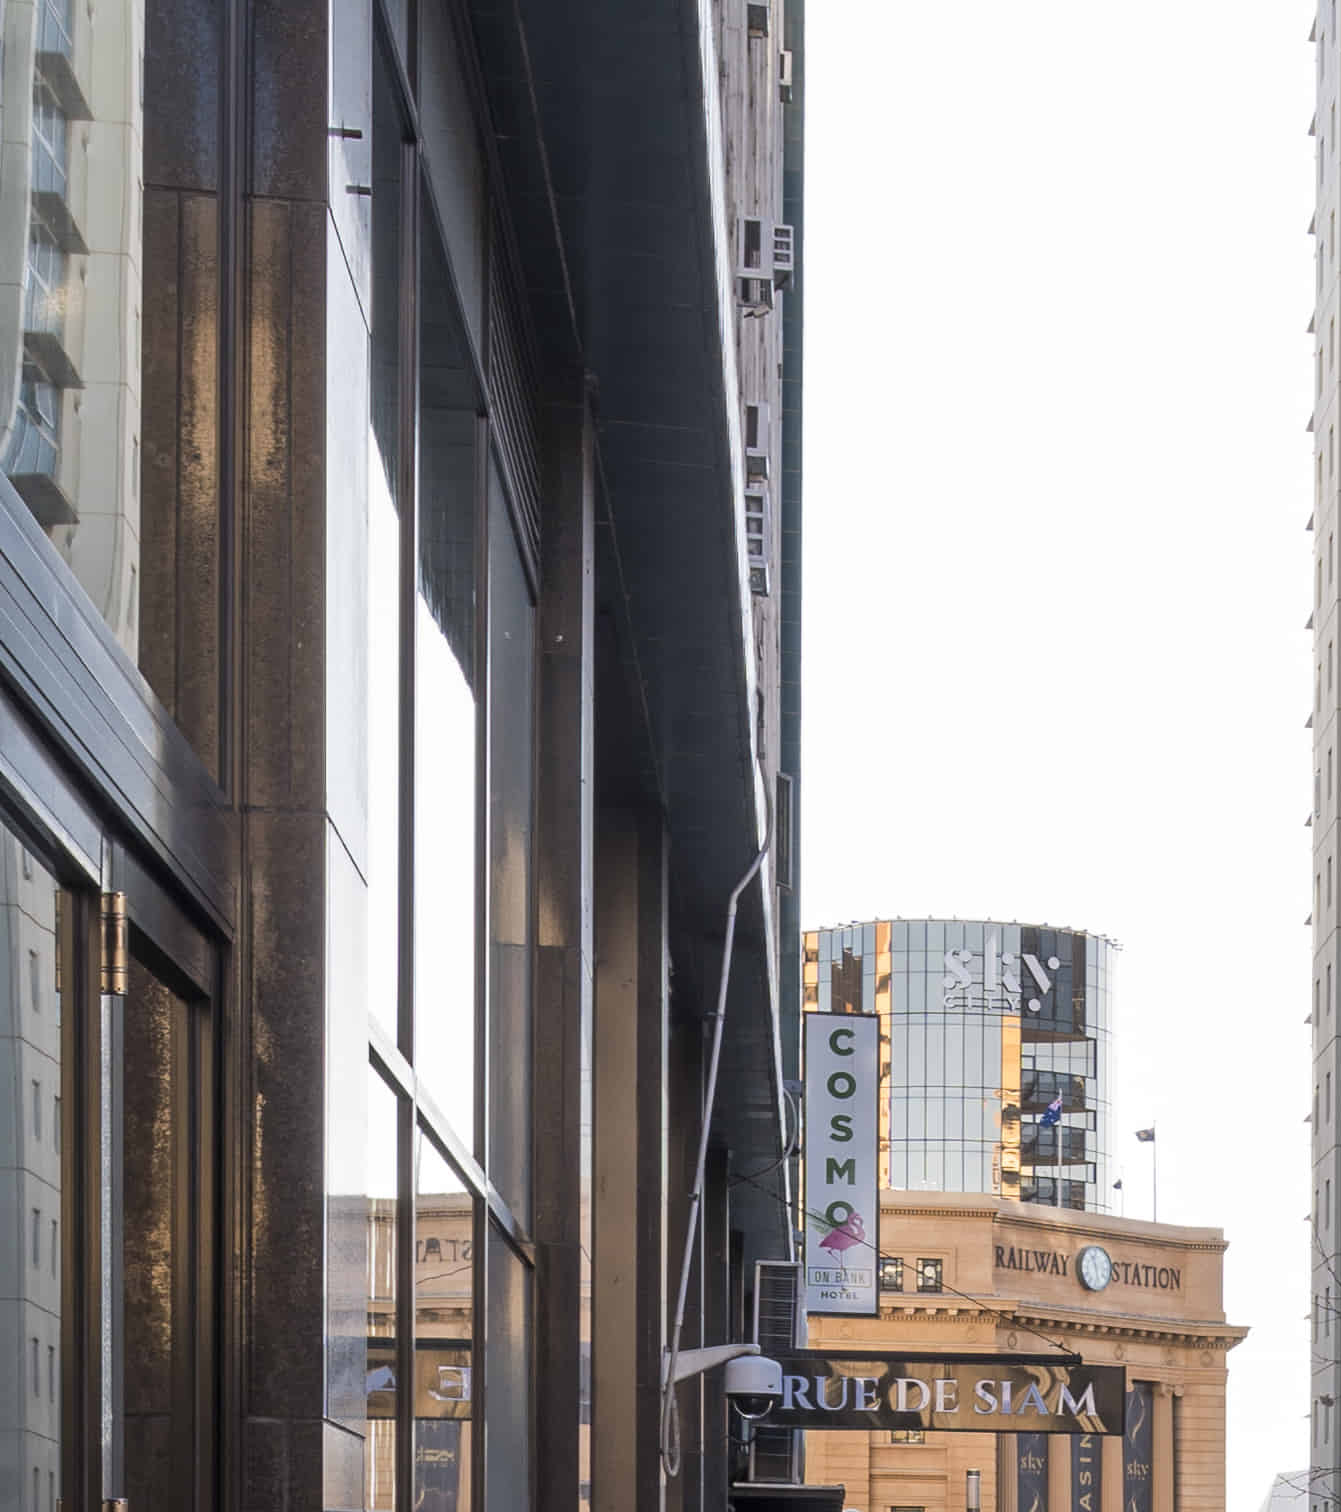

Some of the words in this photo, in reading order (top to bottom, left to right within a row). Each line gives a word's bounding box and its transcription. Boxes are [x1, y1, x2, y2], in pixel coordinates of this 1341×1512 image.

[944, 996, 1020, 1010] CITY
[826, 1028, 856, 1228] COSMO
[815, 1271, 829, 1283] ON
[835, 1271, 865, 1283] BANK
[995, 1245, 1070, 1277] RAILWAY
[1111, 1262, 1181, 1290] STATION
[821, 1291, 859, 1299] HOTEL
[782, 1375, 881, 1413] RUE
[894, 1378, 959, 1413] DE
[974, 1380, 1101, 1417] SIAM
[1080, 1434, 1093, 1511] ASIN
